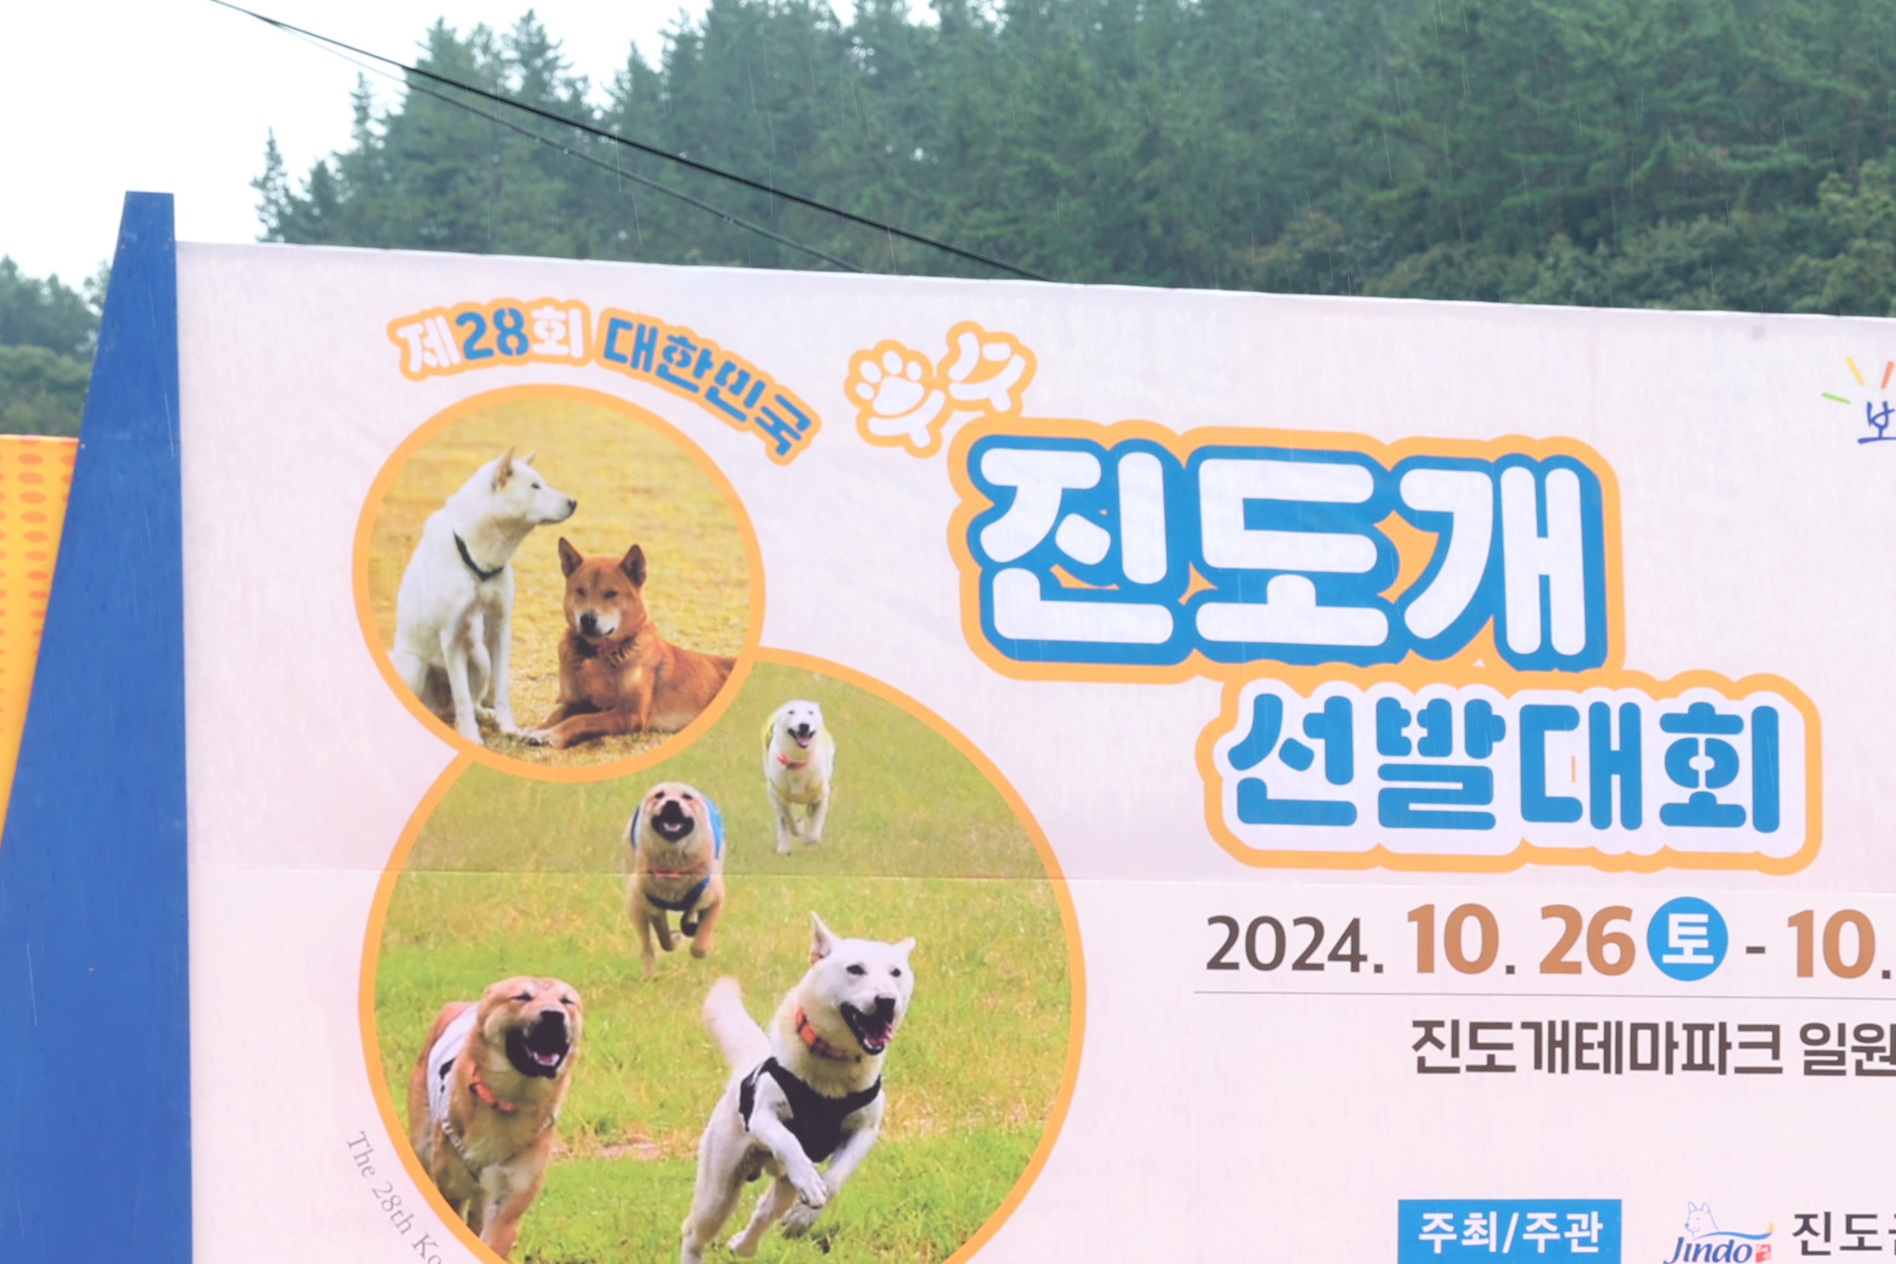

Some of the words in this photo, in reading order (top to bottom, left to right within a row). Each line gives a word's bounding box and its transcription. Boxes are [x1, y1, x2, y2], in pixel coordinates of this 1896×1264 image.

[396, 306, 584, 370] 제28회
[604, 316, 812, 457] 대한민국
[978, 445, 1588, 657] 진도개
[1226, 691, 1781, 834] 선발대회
[1205, 914, 1385, 975] 2024.
[1410, 1019, 1784, 1076] 진도개테마파크
[346, 1129, 378, 1180] The
[370, 1181, 414, 1237] 28th
[1417, 1209, 1604, 1255] 주최/주관
